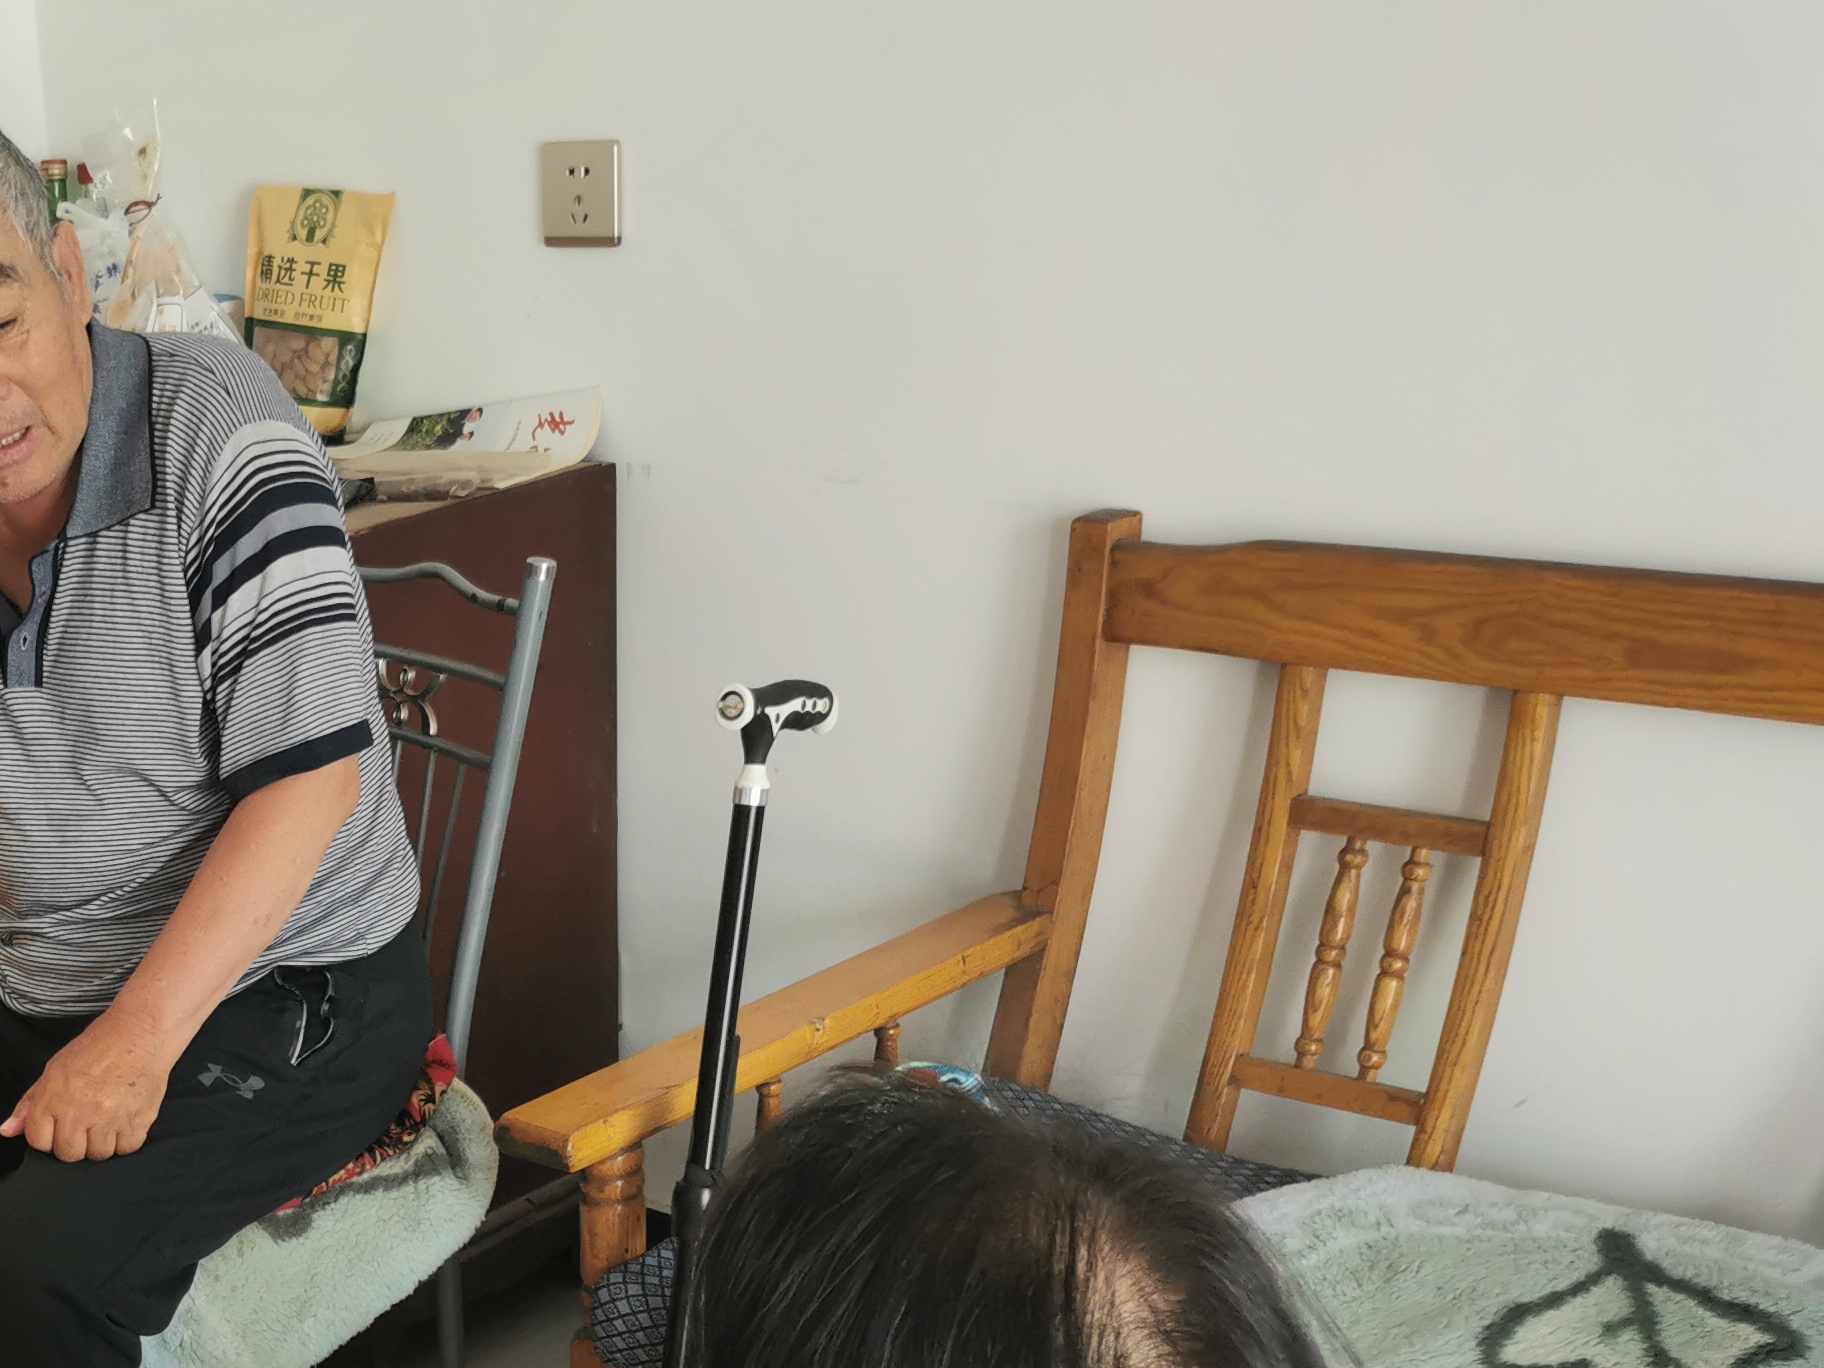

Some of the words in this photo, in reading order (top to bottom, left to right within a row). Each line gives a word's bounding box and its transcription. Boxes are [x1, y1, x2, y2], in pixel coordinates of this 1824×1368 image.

[260, 253, 347, 294] 精选干果
[256, 287, 295, 306] DRIED
[297, 292, 350, 314] FRUIT
